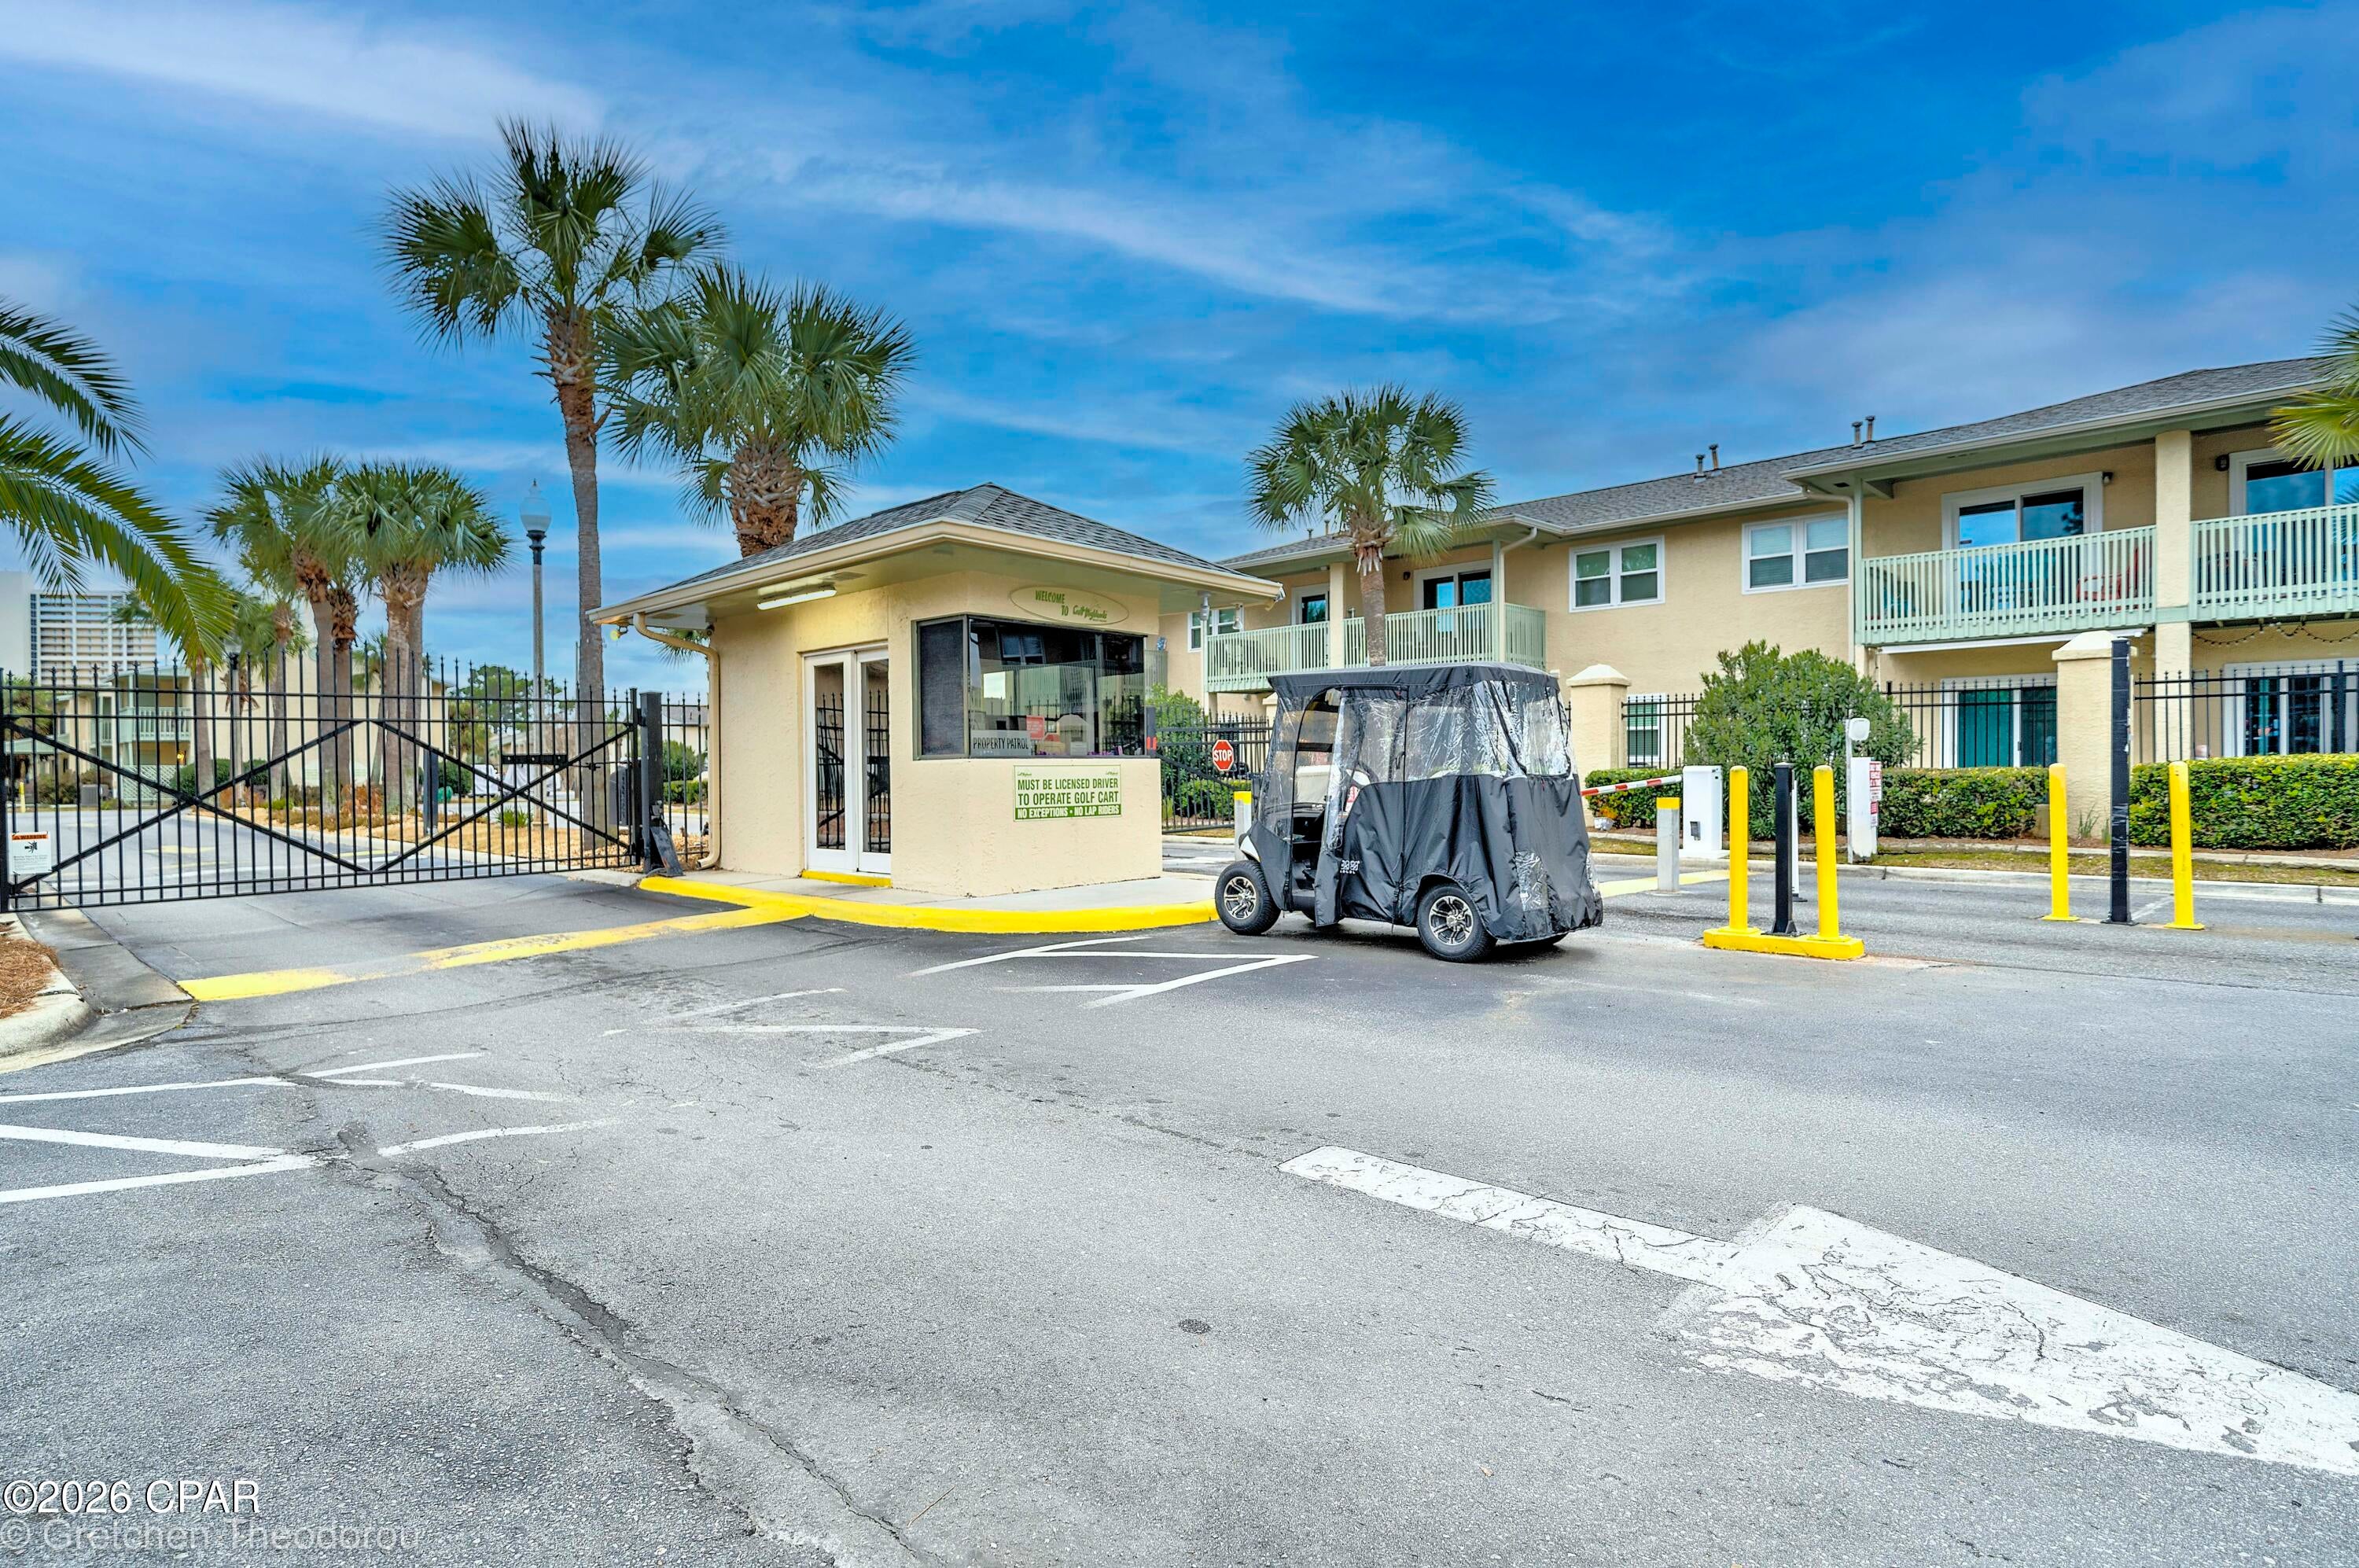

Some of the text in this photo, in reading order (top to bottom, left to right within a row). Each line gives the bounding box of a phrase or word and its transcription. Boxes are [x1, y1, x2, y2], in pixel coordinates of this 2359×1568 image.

[1035, 590, 1065, 604] WELCOME
[1062, 605, 1069, 617] TO
[973, 737, 1029, 749] PROPERTY PATROL
[1213, 749, 1233, 762] STOP
[1018, 778, 1118, 790] MUST BE LICENSED DRIVER
[1018, 791, 1119, 806] TO OPERATE GOLF CART
[1018, 805, 1120, 819] NO EXCEPTIONS NO LAP RIDERS
